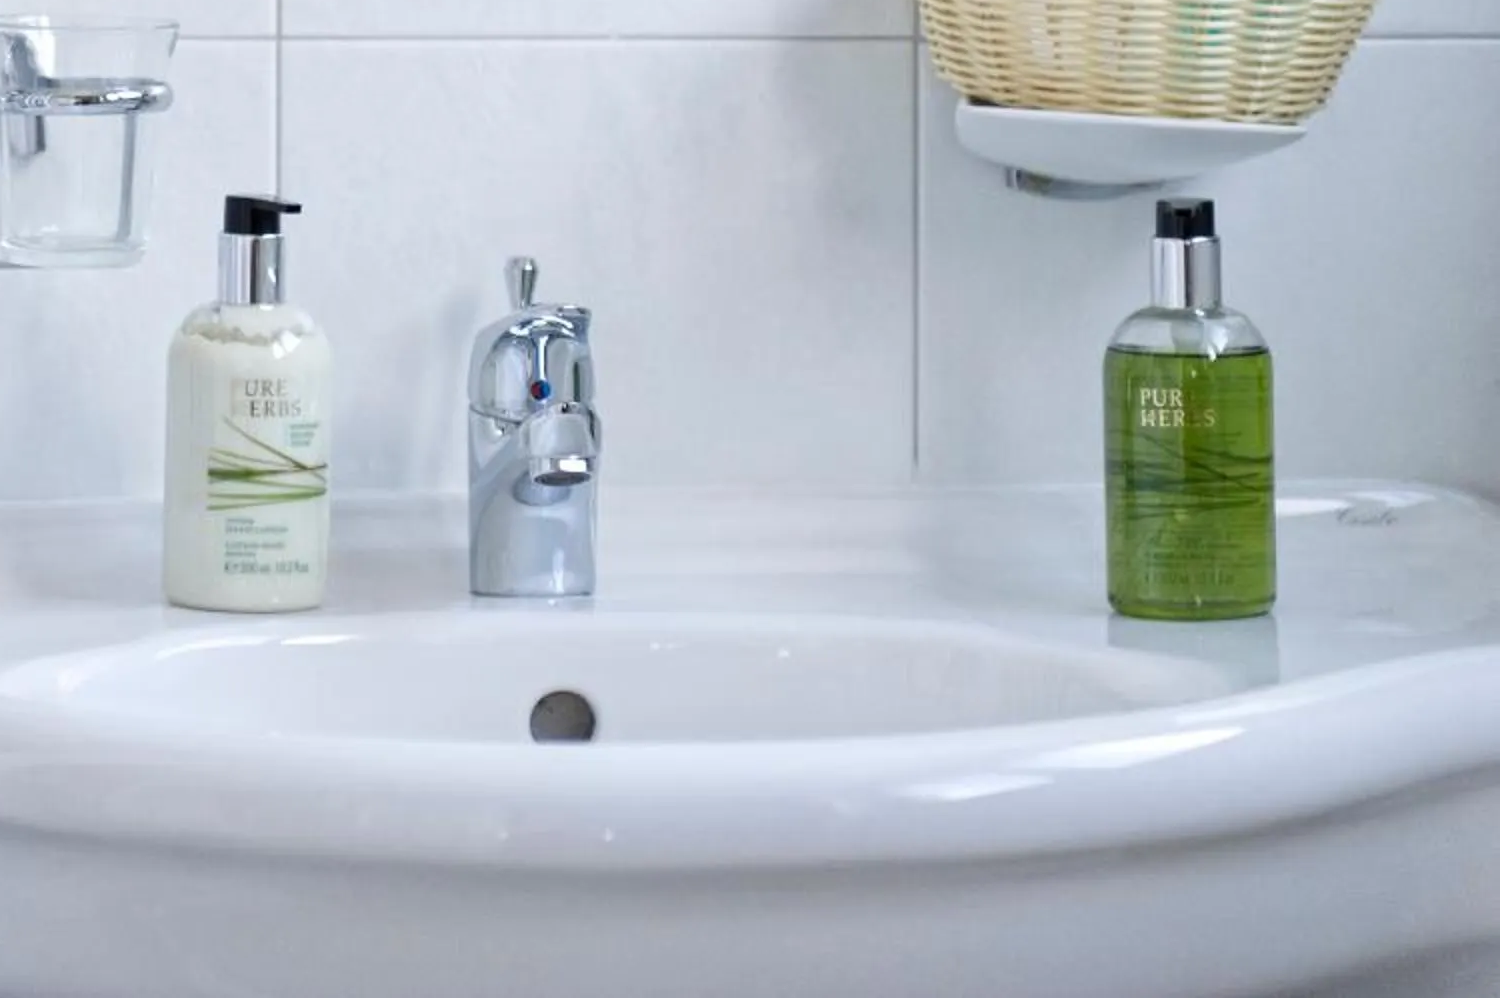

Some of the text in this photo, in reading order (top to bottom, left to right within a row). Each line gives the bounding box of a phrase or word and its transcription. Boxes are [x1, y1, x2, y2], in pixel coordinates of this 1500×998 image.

[233, 378, 289, 397] URE
[1140, 388, 1196, 407] PUR
[233, 399, 302, 418] ERBS
[1141, 408, 1216, 427] HERS
